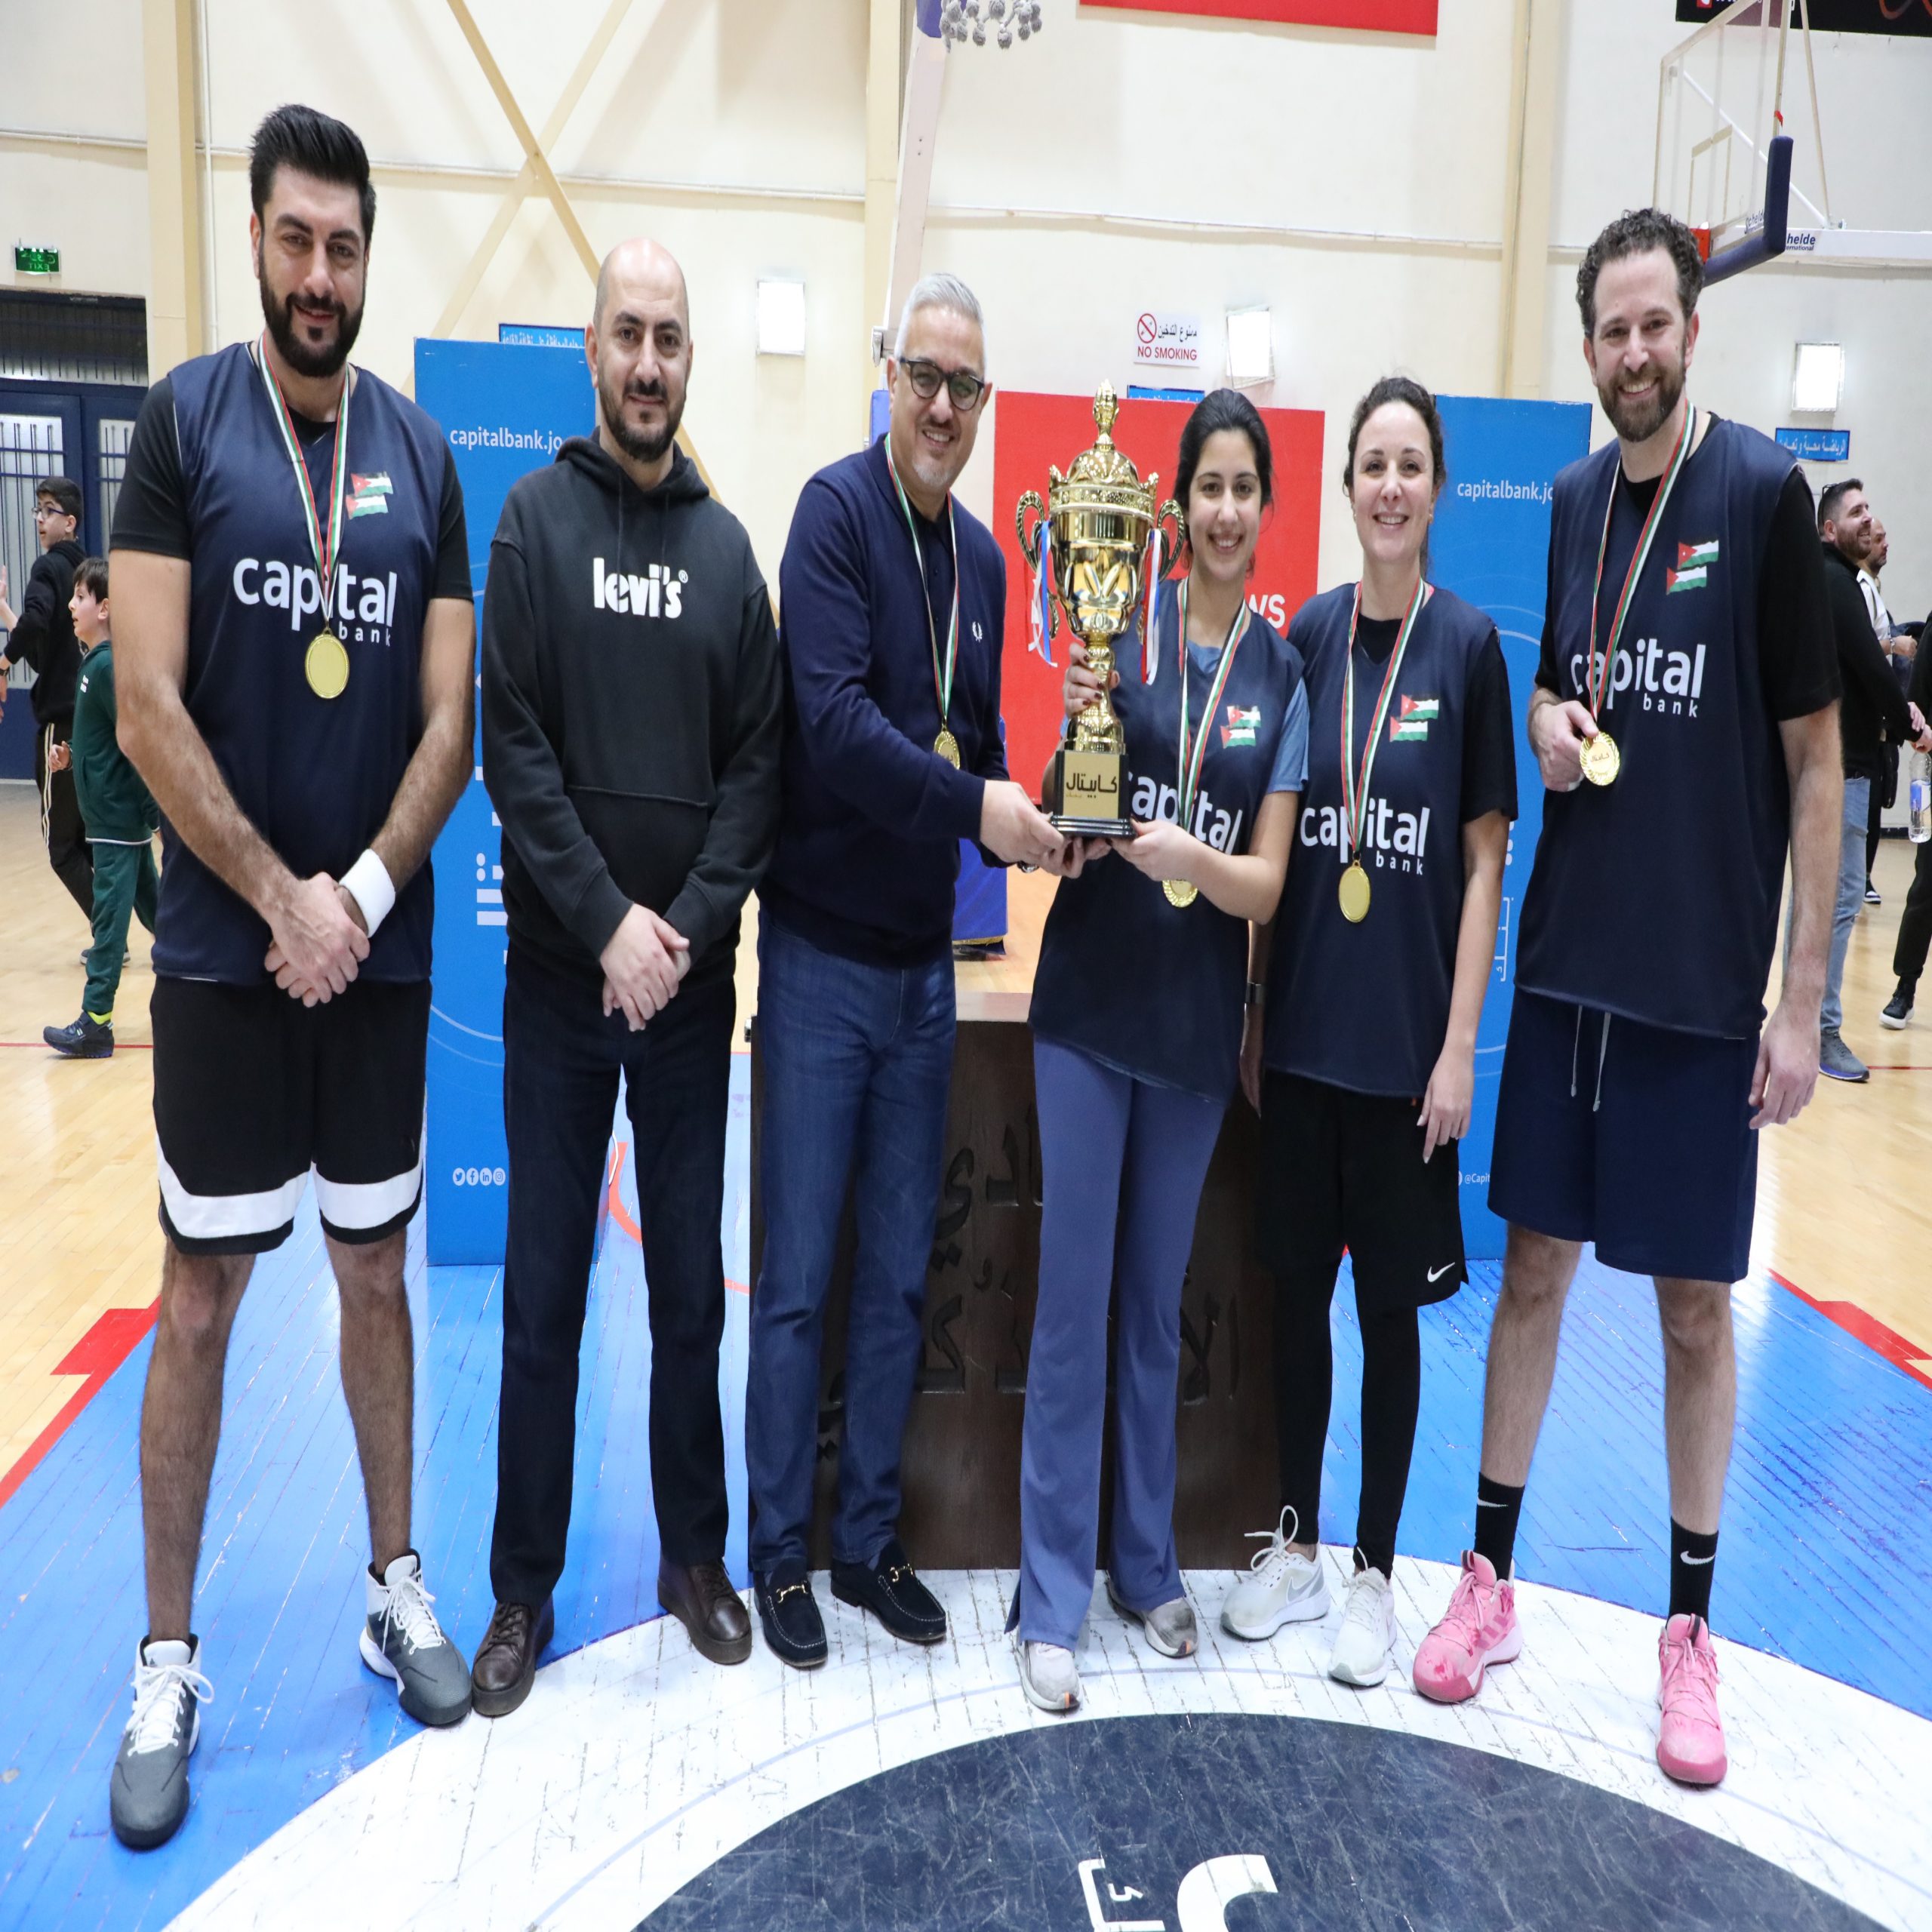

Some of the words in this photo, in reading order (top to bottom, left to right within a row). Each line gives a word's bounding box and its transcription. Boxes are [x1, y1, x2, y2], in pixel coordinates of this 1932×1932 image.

[1744, 209, 1764, 234] Scheld
[1786, 234, 1816, 245] helde
[1158, 323, 1177, 339] التدخين
[1137, 346, 1152, 358] NO
[1155, 347, 1197, 361] SMOKING
[450, 426, 563, 455] capitalbank.jo
[339, 621, 390, 647] bank
[1643, 692, 1699, 718] bank
[1066, 773, 1117, 798] كابيتال
[1376, 851, 1423, 875] bank
